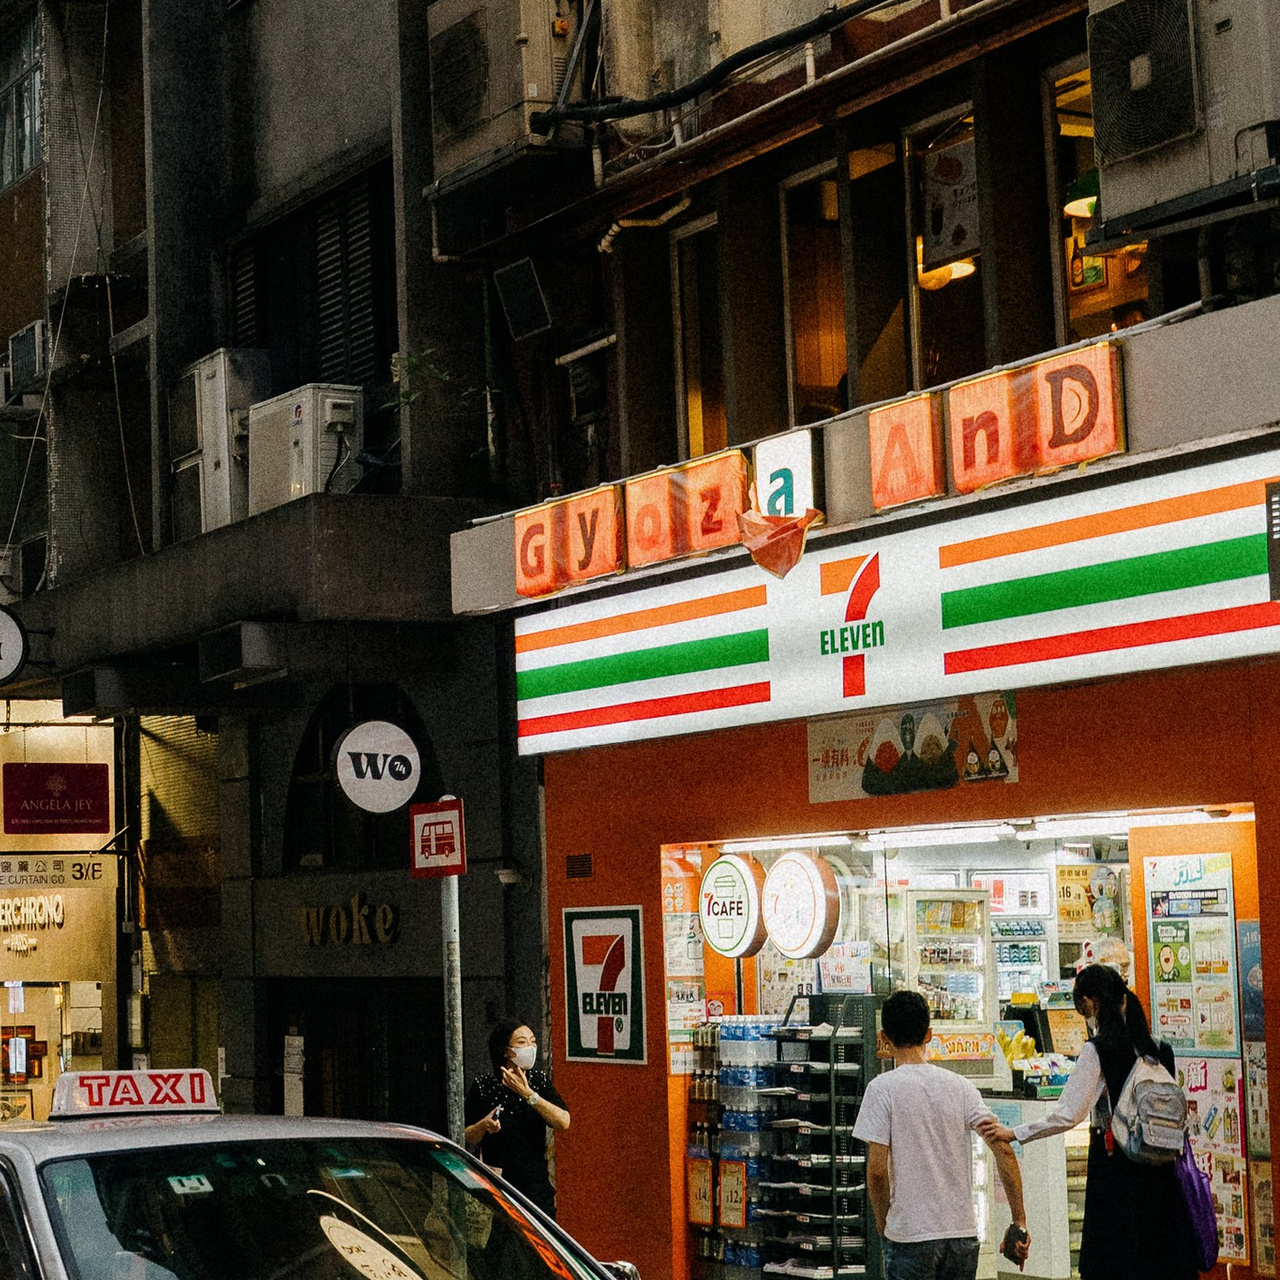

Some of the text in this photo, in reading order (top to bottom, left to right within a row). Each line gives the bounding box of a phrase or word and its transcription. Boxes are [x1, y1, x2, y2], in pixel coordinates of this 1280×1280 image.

[519, 466, 795, 578] Gyoza
[820, 552, 881, 698] 7
[21, 799, 93, 812] ANGELA JEY
[8, 875, 48, 885] CURTAIN
[298, 894, 394, 946] woke
[581, 934, 626, 1055] 7
[78, 1072, 206, 1107] TAXI
